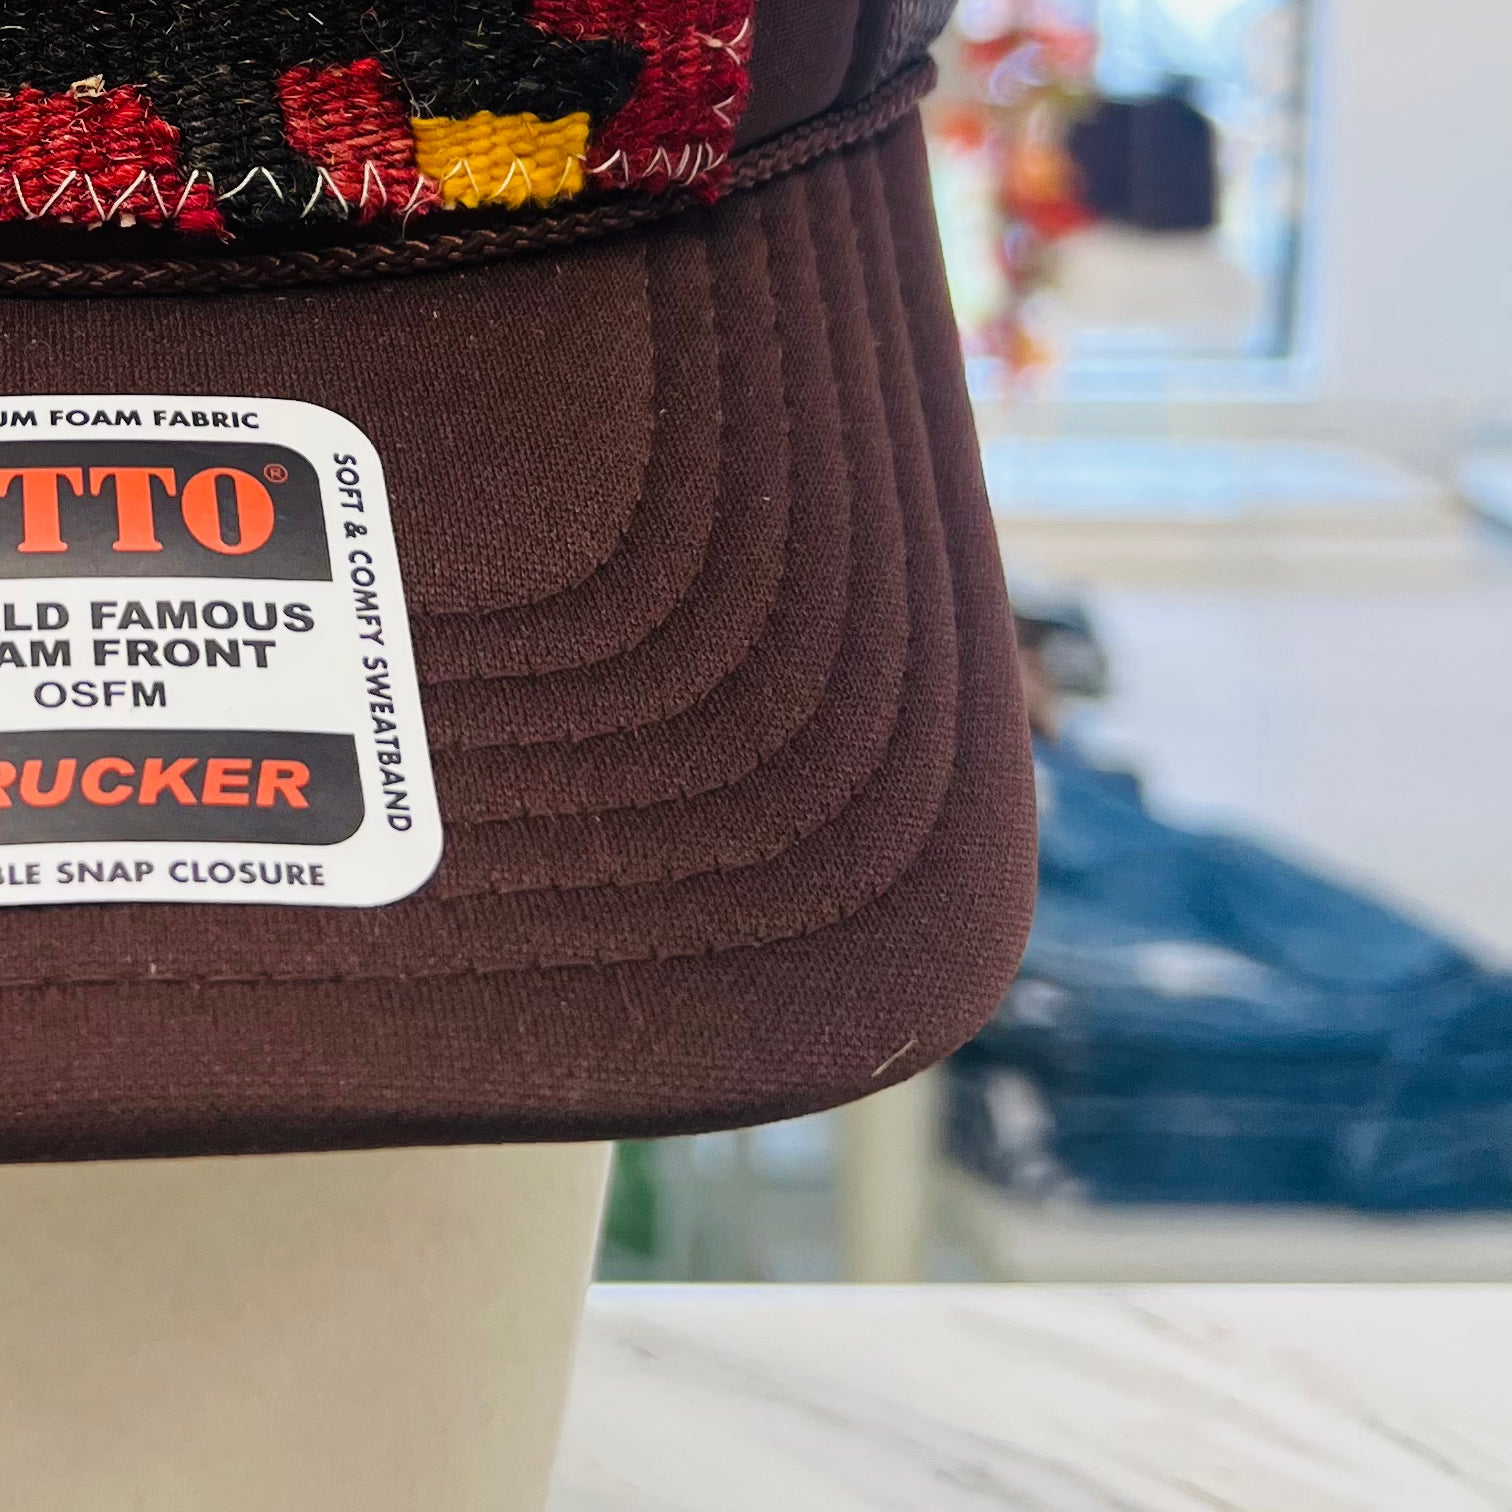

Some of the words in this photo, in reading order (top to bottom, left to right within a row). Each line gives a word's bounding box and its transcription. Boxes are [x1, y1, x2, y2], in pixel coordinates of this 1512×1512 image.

[49, 408, 143, 428] FOAM
[153, 410, 260, 430] FABRIC
[333, 452, 365, 513] SOFT
[344, 523, 361, 540] &
[349, 550, 385, 646] COMFY
[90, 601, 315, 633] FAMOUS
[93, 639, 277, 669] FRONT
[33, 680, 168, 710] OSFM
[363, 656, 413, 832] SWEATBAND
[56, 861, 155, 886] SNAP
[169, 861, 326, 887] CLOSURE
